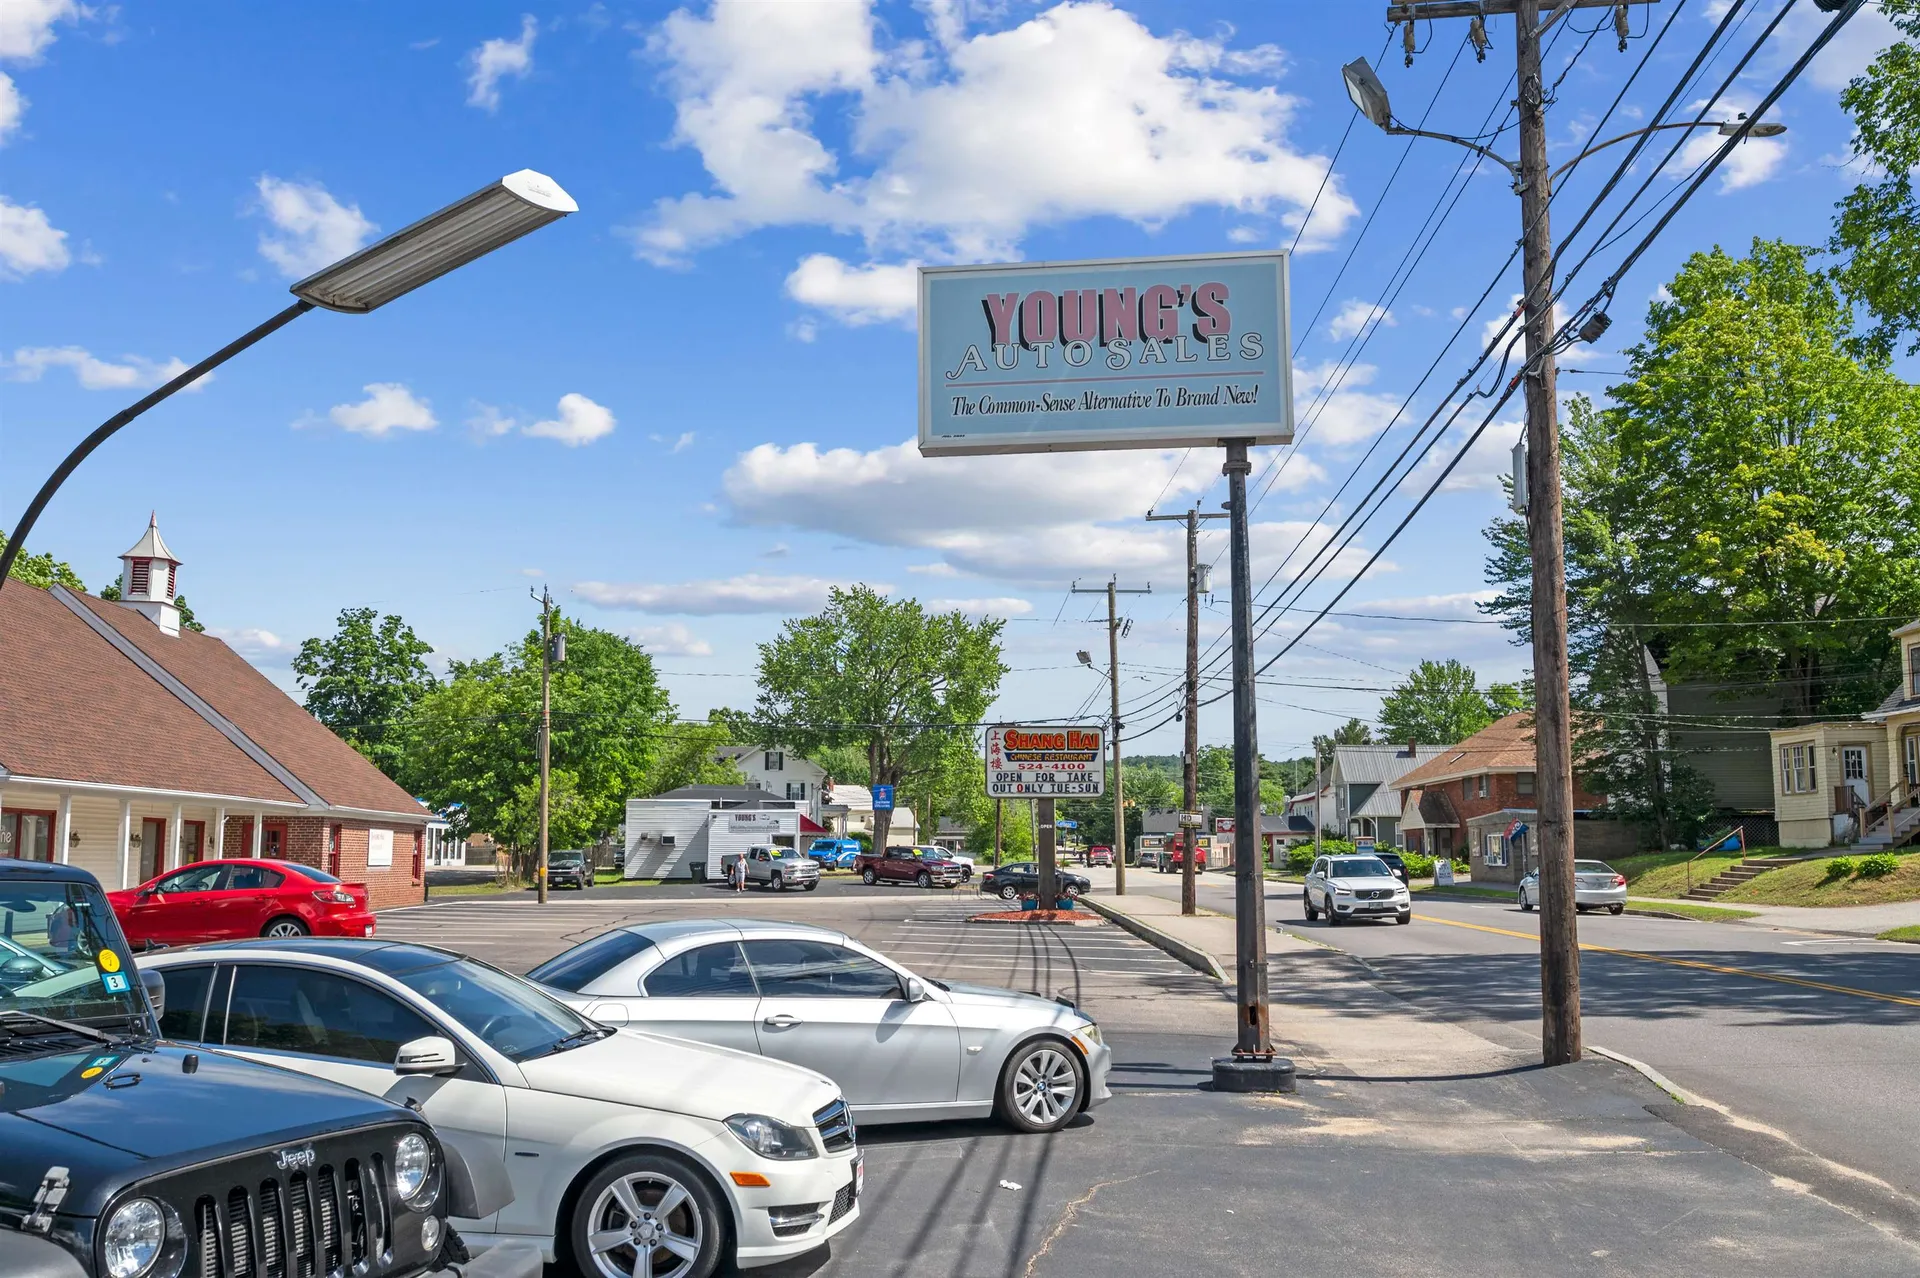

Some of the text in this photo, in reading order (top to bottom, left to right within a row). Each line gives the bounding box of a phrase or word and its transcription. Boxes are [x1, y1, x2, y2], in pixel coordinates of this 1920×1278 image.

[981, 281, 1232, 350] YOUNG'S
[952, 384, 1259, 416] The Common-Sense Alternative To Brand New!
[1003, 729, 1099, 750] SHANG HAI
[1010, 753, 1092, 761] CHINESE RESTAURANT
[996, 772, 1093, 782] OPEN FOR TAKE
[992, 783, 1099, 793] OUT ONLY TUE-SUN
[735, 814, 756, 822] YOUNG'S
[110, 977, 119, 988] 3
[276, 1149, 316, 1170] Jeep
